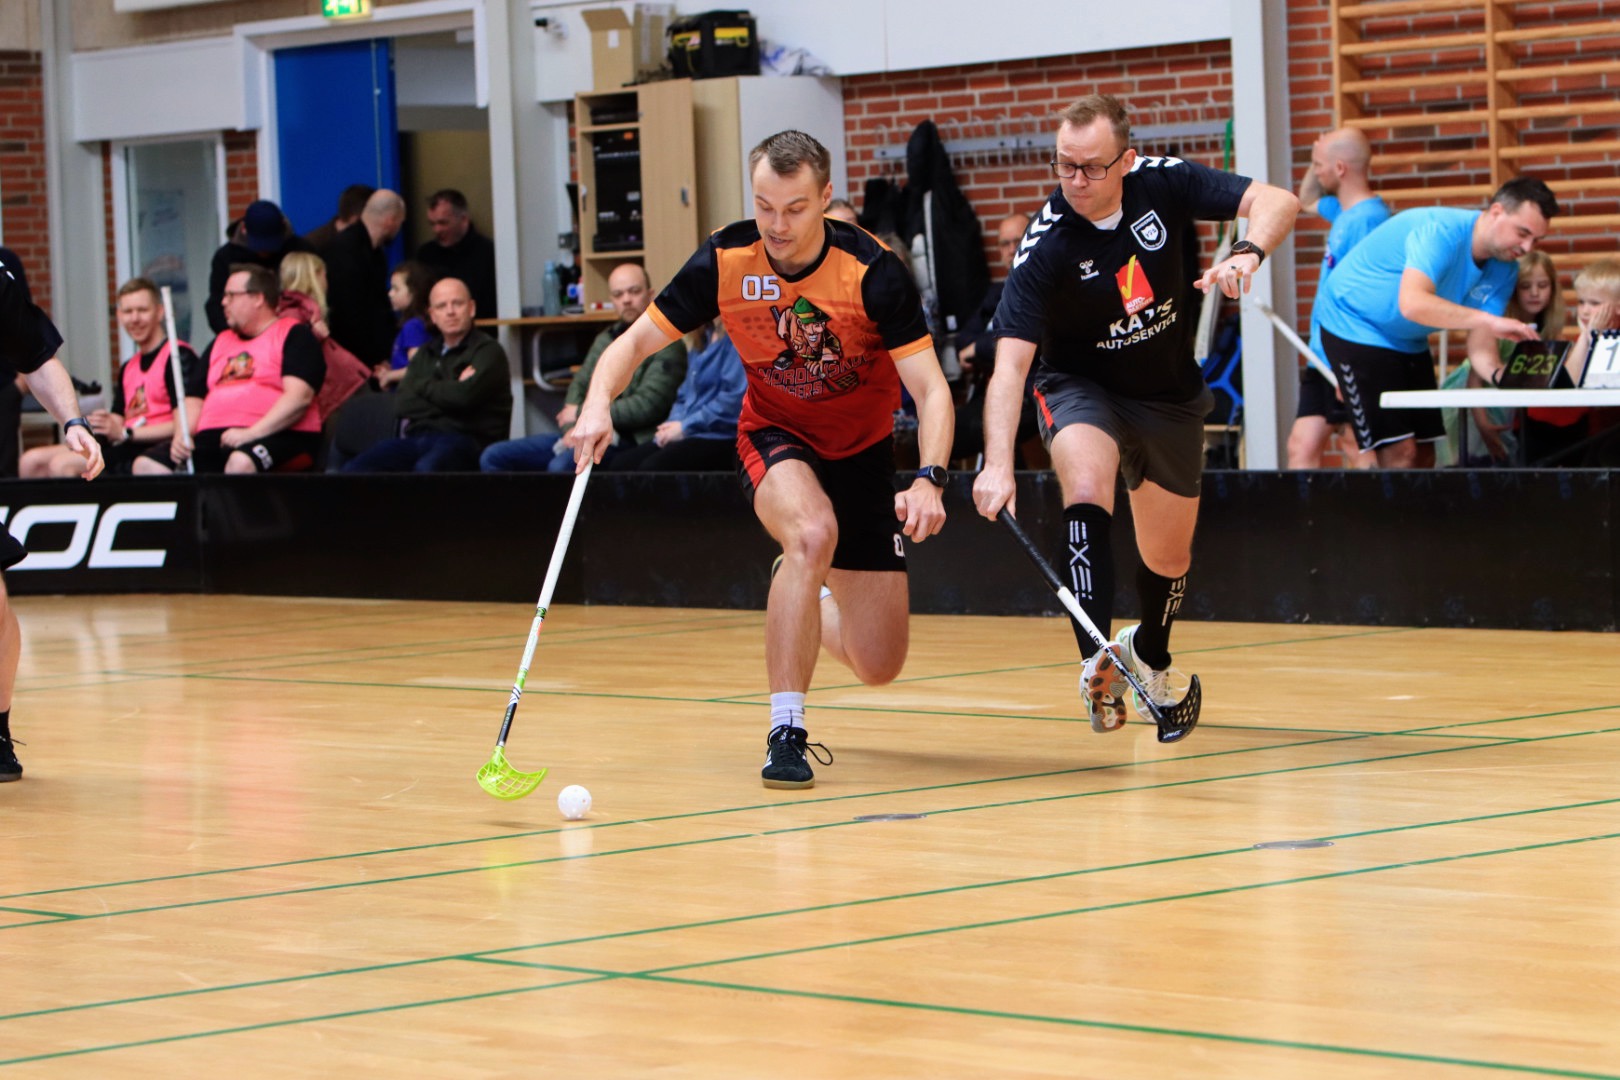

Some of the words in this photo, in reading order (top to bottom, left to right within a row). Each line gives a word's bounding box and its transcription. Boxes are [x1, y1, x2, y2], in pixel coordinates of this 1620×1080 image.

[741, 275, 781, 301] 05
[1096, 311, 1178, 349] AUTOSERVICE
[1510, 354, 1557, 375] 6:23
[0, 502, 178, 571] OC
